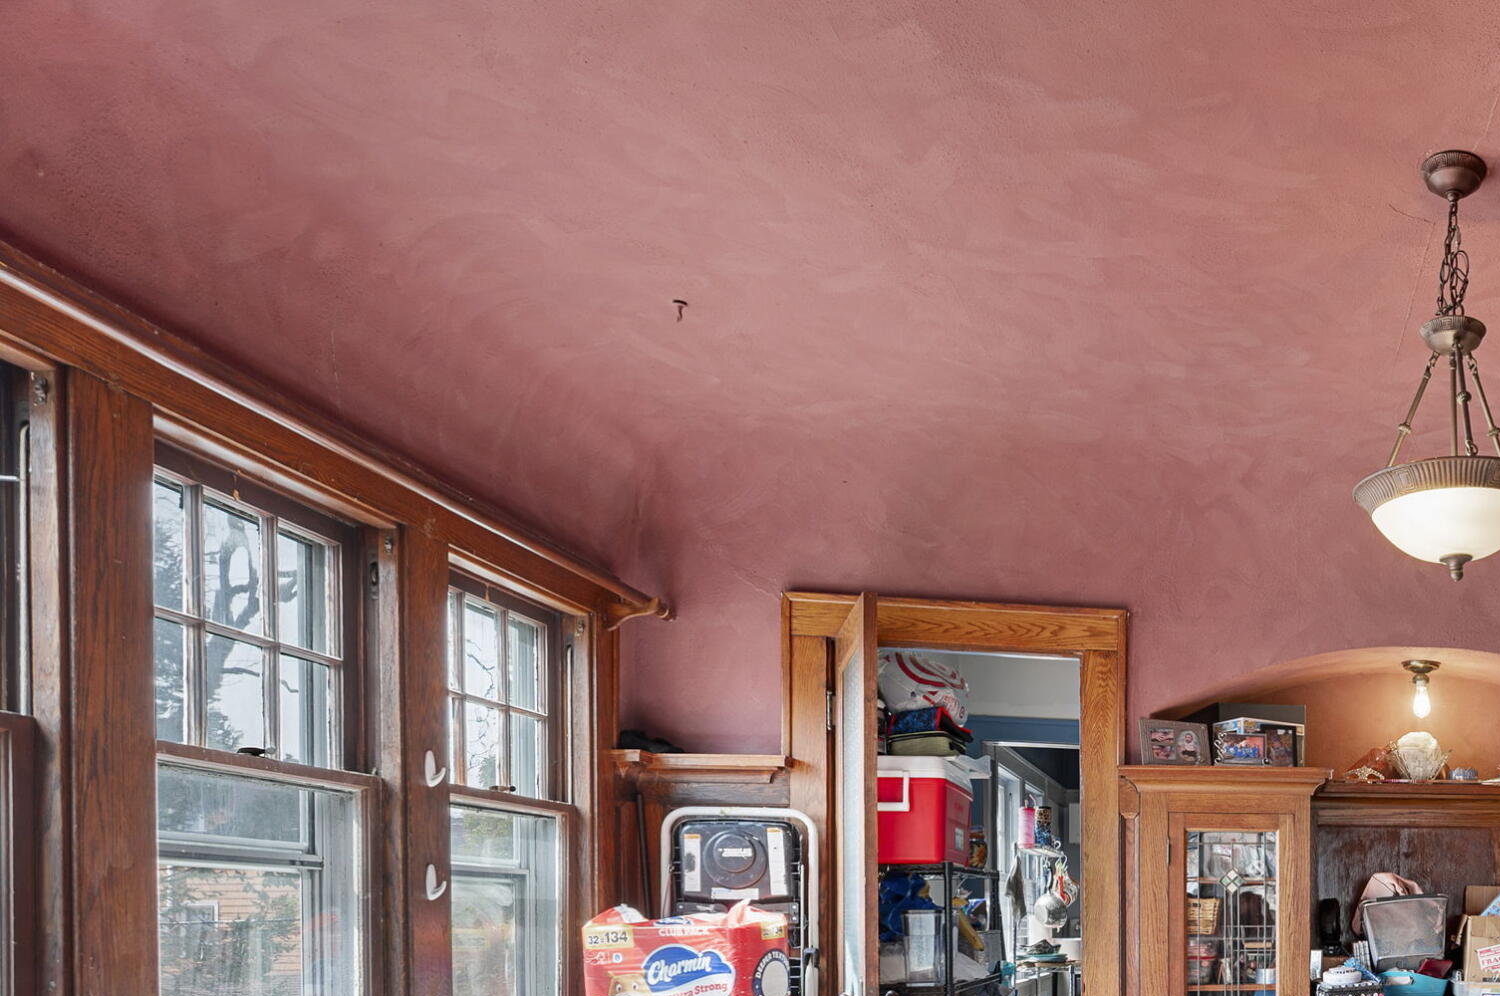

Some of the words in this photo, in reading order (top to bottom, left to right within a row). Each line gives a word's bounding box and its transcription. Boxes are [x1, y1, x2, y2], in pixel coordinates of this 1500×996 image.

[605, 931, 628, 944] 134
[648, 956, 712, 985] Charmin
[694, 983, 728, 995] Strong
